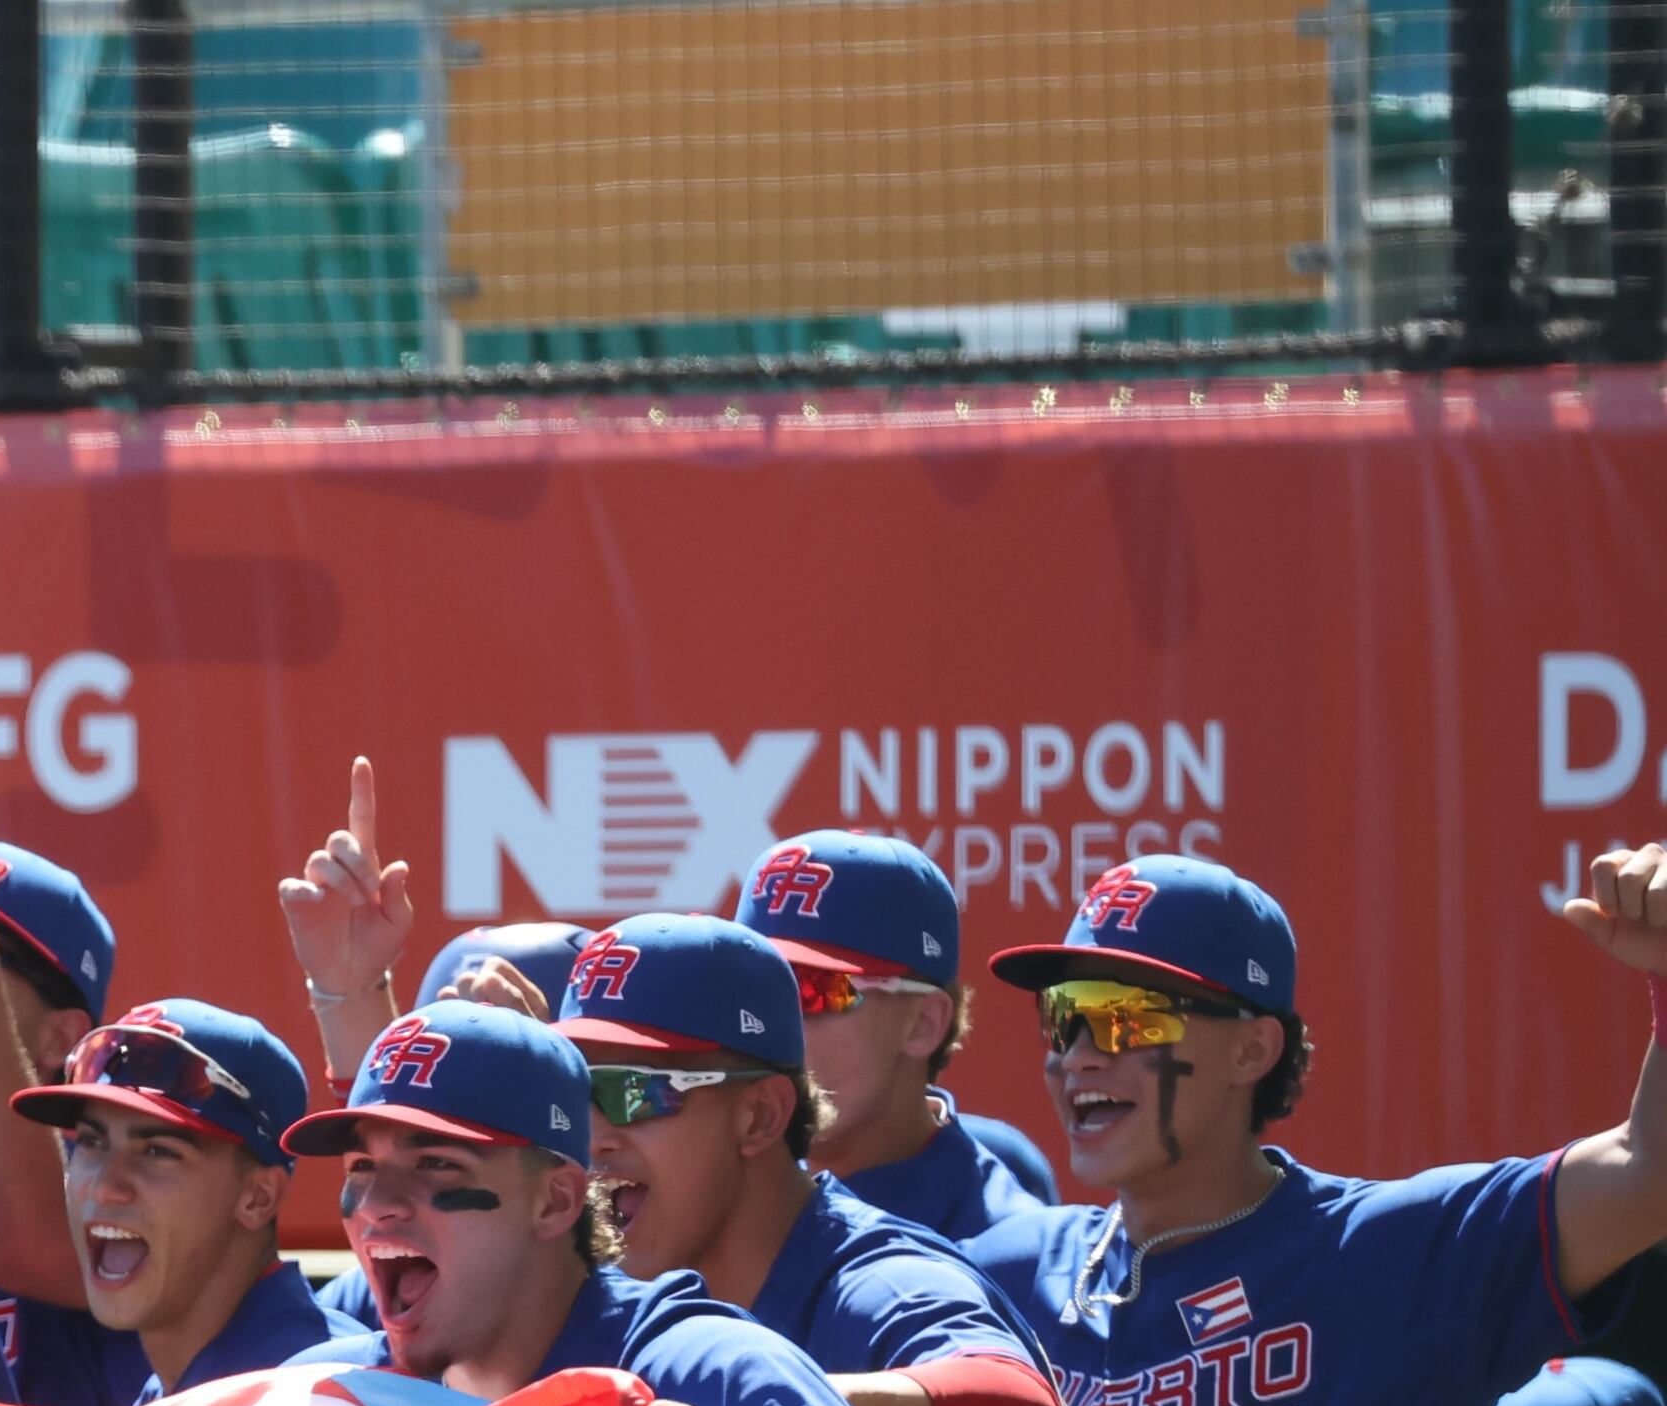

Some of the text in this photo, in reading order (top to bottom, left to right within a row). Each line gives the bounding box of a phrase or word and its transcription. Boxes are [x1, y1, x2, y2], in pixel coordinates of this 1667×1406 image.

[1539, 651, 1667, 810] D
[839, 719, 1227, 818] NIPPON
[443, 729, 821, 921] NX
[752, 844, 835, 919] PR
[1080, 864, 1158, 933] PR
[570, 929, 643, 1001] PR
[367, 1015, 452, 1090] PR
